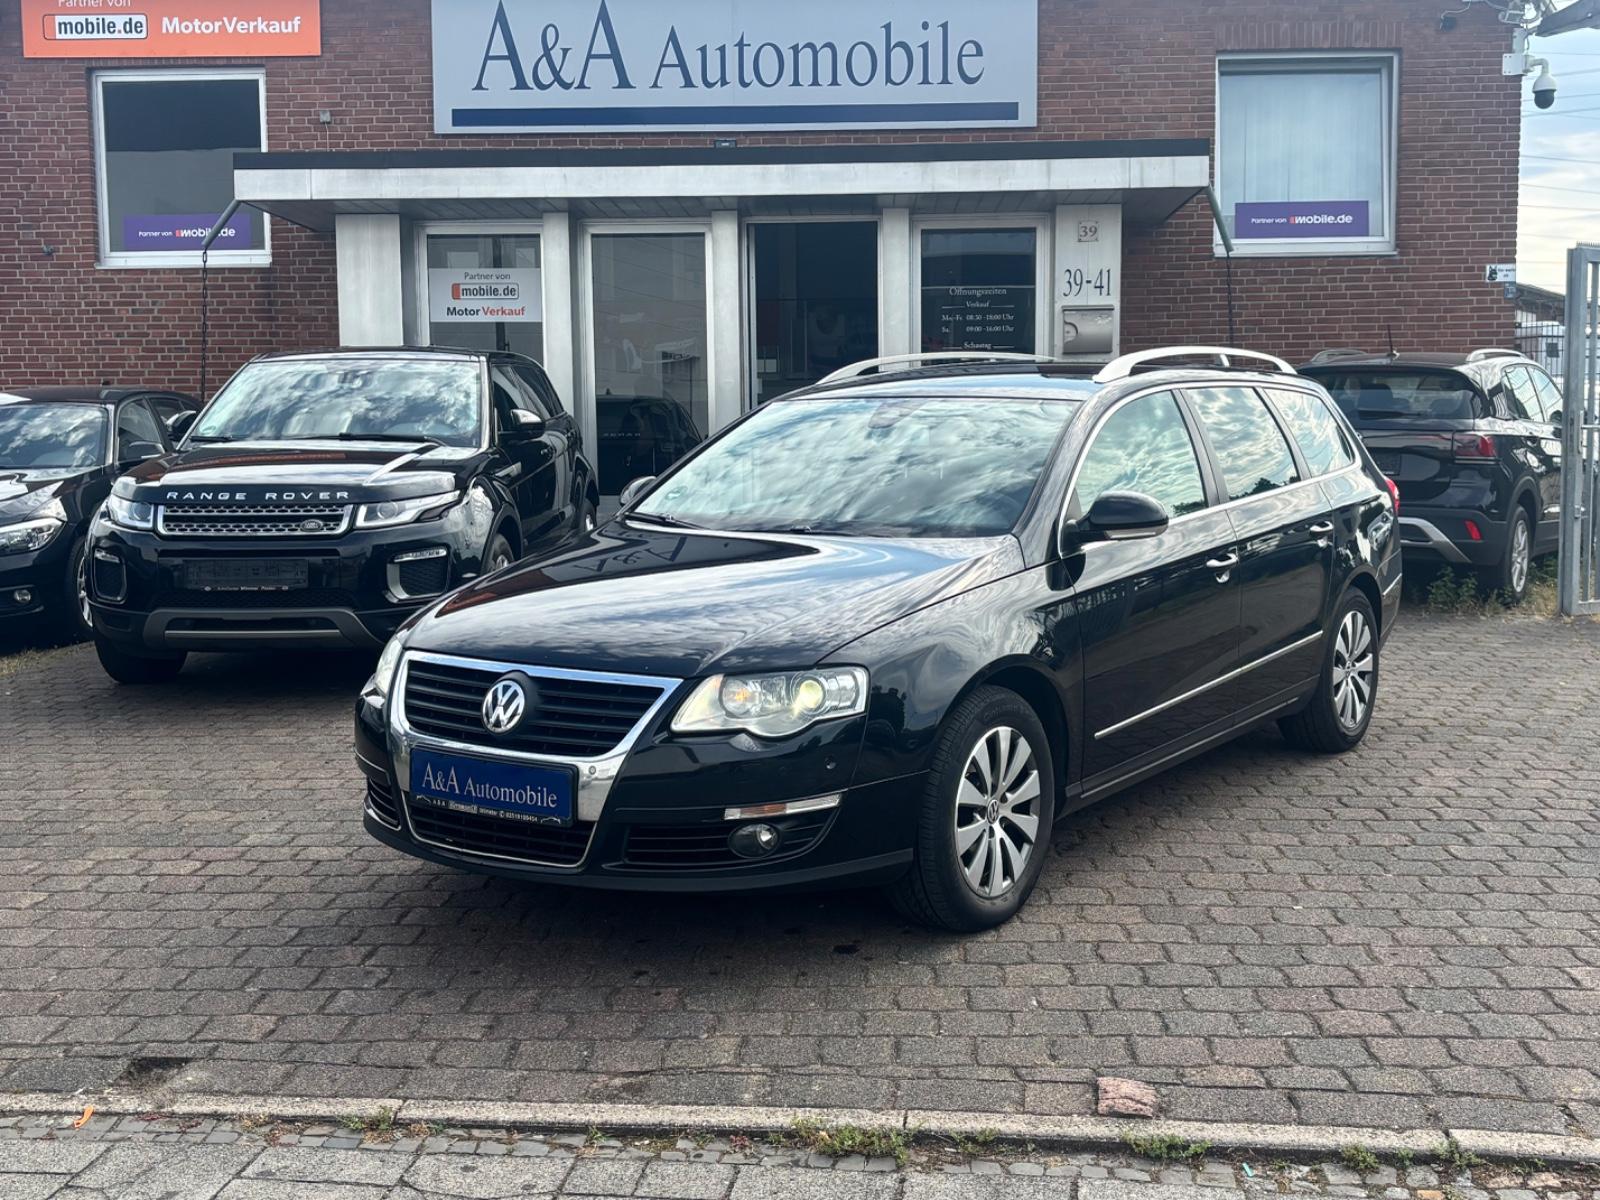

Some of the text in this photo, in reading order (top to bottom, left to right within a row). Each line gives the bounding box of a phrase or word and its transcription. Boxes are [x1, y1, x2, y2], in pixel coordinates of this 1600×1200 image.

[57, 17, 144, 35] mobile.de
[472, 0, 985, 91] A&A Automobile
[1295, 214, 1353, 224] mobile.de
[1079, 225, 1098, 238] 39
[464, 272, 493, 280] Partner
[1063, 268, 1111, 297] 39-41
[461, 285, 516, 297] mobile.de
[166, 491, 349, 500] RANGE ROVER
[422, 762, 460, 794] A&A
[464, 777, 558, 808] Automobile
